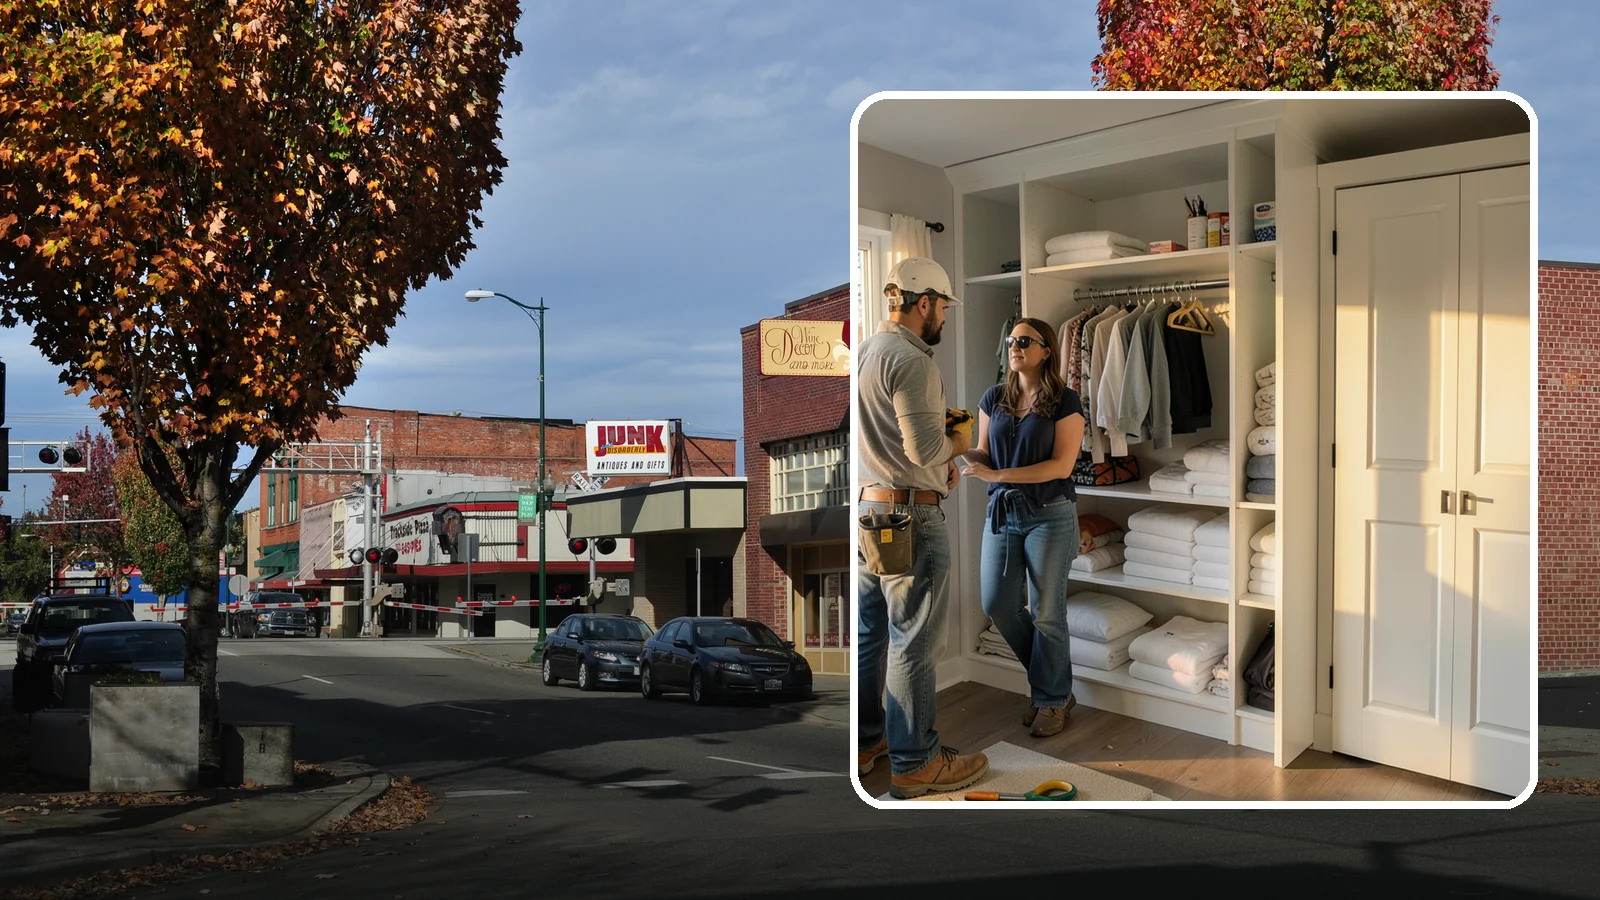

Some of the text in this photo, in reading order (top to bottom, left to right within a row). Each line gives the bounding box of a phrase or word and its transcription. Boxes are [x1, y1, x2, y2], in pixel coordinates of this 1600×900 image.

[595, 425, 664, 457] JUNK
[607, 446, 646, 454] DISORDERLY
[597, 461, 665, 470] ANTIQUES AND GIFTS
[573, 473, 589, 491] RAIL
[415, 519, 429, 535] Pizza
